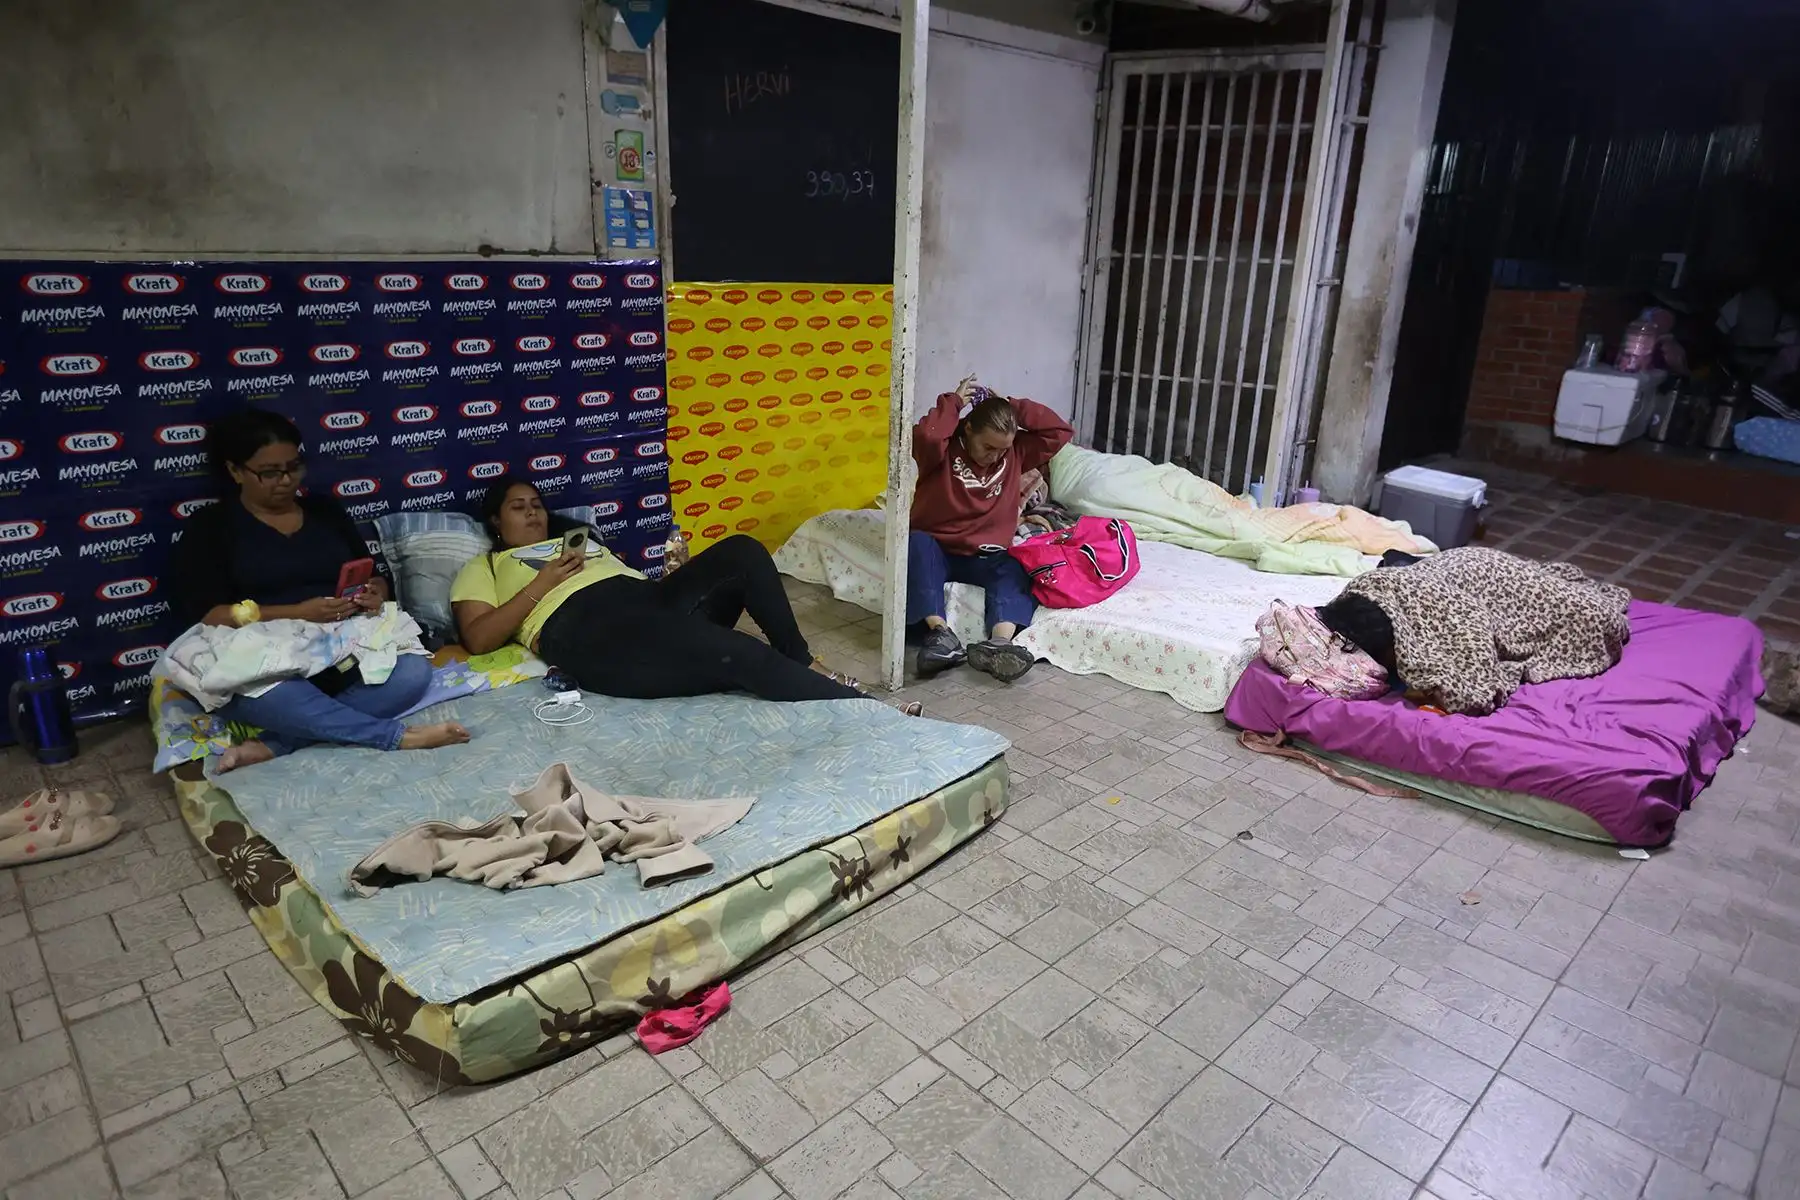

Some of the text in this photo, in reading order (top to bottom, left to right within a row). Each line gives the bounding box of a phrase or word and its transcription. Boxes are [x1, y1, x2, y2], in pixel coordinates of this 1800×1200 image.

[35, 278, 75, 290] Kraft
[136, 278, 172, 290] Kraft
[226, 278, 259, 289] Kraft
[309, 278, 339, 288] Kraft
[384, 277, 412, 288] Kraft
[453, 276, 479, 288] Kraft
[517, 276, 541, 288] Kraft
[576, 276, 599, 287] Kraft
[630, 276, 651, 286] Kraft
[297, 301, 361, 316] MAYONESA
[373, 300, 431, 315] MAYONESA
[443, 299, 496, 313] MAYONESA
[507, 298, 557, 311] MAYONESA
[567, 297, 612, 310] MAYONESA
[621, 296, 663, 309] MAYONESA
[22, 306, 105, 323] MAYONESA
[123, 304, 198, 320] MAYONESA
[214, 303, 283, 318] MAYONESA
[461, 339, 486, 352] Kraft
[524, 339, 546, 351] Kraft
[581, 334, 602, 346] Kraft
[634, 333, 654, 345] Kraft
[320, 347, 350, 359] Kraft
[394, 343, 421, 356] Kraft
[152, 354, 187, 367] Kraft
[240, 351, 271, 363] Kraft
[571, 355, 616, 369] MAYONESA
[54, 358, 93, 371] Kraft
[451, 362, 503, 377] MAYONESA
[513, 358, 562, 373] MAYONESA
[309, 370, 370, 385] MAYONESA
[383, 366, 439, 382] MAYONESA
[139, 380, 212, 397] MAYONESA
[227, 374, 295, 392] MAYONESA
[41, 384, 122, 403] MAYONESA
[585, 392, 606, 404] Kraft
[637, 390, 656, 401] Kraft
[468, 402, 492, 414] Kraft
[529, 396, 551, 408] Kraft
[331, 413, 358, 426] Kraft
[402, 409, 428, 422] Kraft
[575, 411, 619, 427] MAYONESA
[628, 407, 668, 421] MAYONESA
[458, 422, 508, 439] MAYONESA
[519, 417, 566, 433] MAYONESA
[167, 428, 201, 440] Kraft
[391, 428, 447, 446] MAYONESA
[73, 435, 110, 449] Kraft
[320, 435, 379, 452] MAYONESA
[641, 443, 661, 454] Kraft
[154, 452, 208, 471] MAYONE
[590, 450, 611, 461] Kraft
[59, 459, 138, 480] MAYONESA
[476, 465, 500, 476] Kraft
[535, 458, 558, 470] Kraft
[632, 461, 669, 476] MAYONES
[0, 468, 40, 484] NESA
[412, 471, 438, 485] Kraft
[581, 467, 625, 484] MAYONESA
[342, 482, 370, 494] Kraft
[401, 491, 455, 510] MAYONESA
[645, 494, 663, 506] Kraft
[346, 500, 390, 517] YONESA
[594, 503, 615, 515] Kraft
[92, 512, 129, 527] Kraft
[636, 513, 672, 528] MAYONES
[79, 533, 156, 557] MAYONESA
[0, 546, 62, 568] YONESA
[109, 582, 144, 596] Kraft
[11, 598, 50, 613] Kraft
[97, 601, 171, 627] MAYONESA
[124, 648, 160, 664] Kraft
